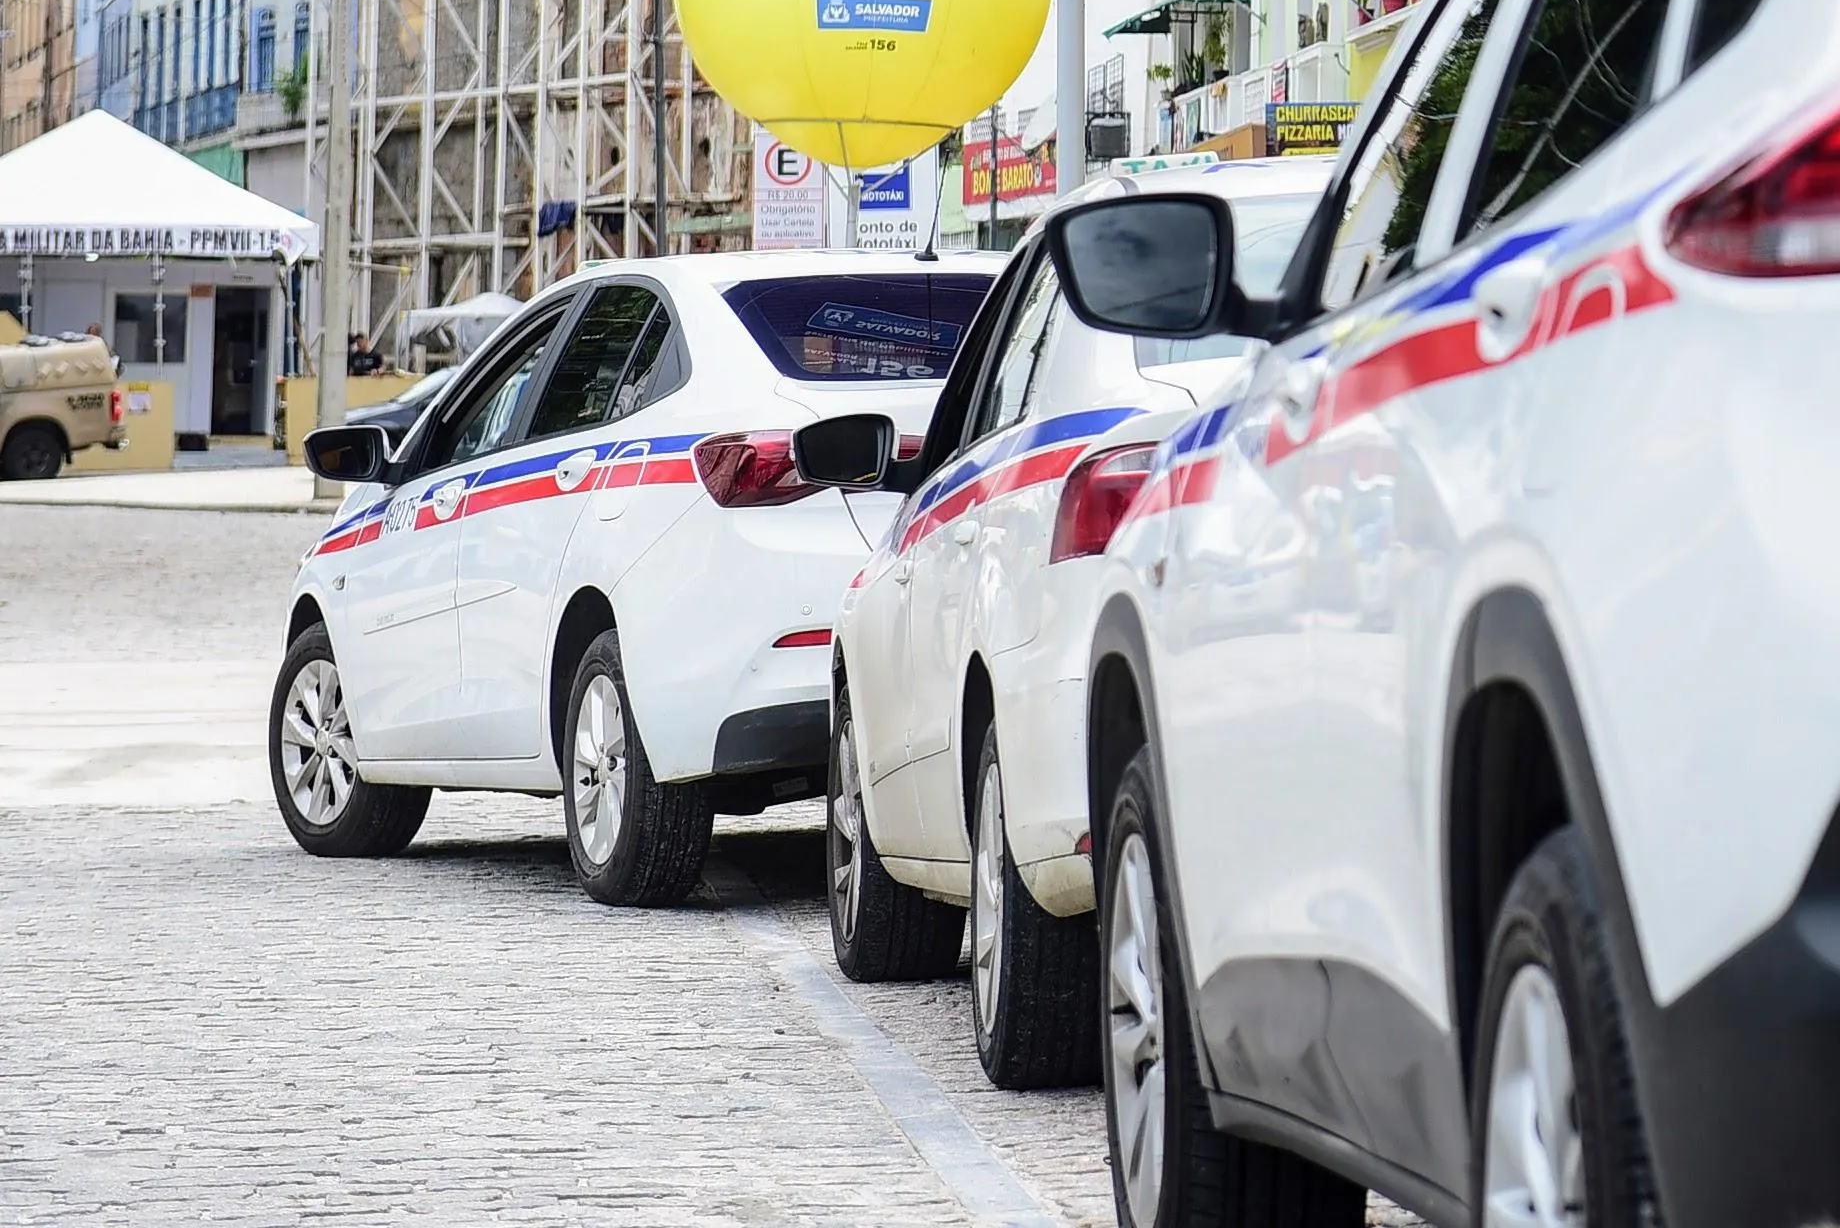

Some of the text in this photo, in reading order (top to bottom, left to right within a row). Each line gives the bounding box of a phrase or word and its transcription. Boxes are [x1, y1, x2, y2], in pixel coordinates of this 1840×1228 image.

[855, 3, 920, 18] SALVADOR
[869, 39, 896, 52] 156
[1276, 124, 1334, 142] PIZZARIA
[778, 149, 799, 176] E
[1002, 162, 1034, 192] BARATO
[862, 188, 904, 202] MOTOTÁXI
[760, 204, 816, 215] Obrigatório
[859, 219, 918, 234] onto de
[14, 227, 85, 251] MILITAR
[91, 228, 114, 251] DA
[120, 228, 174, 251] BAHIA
